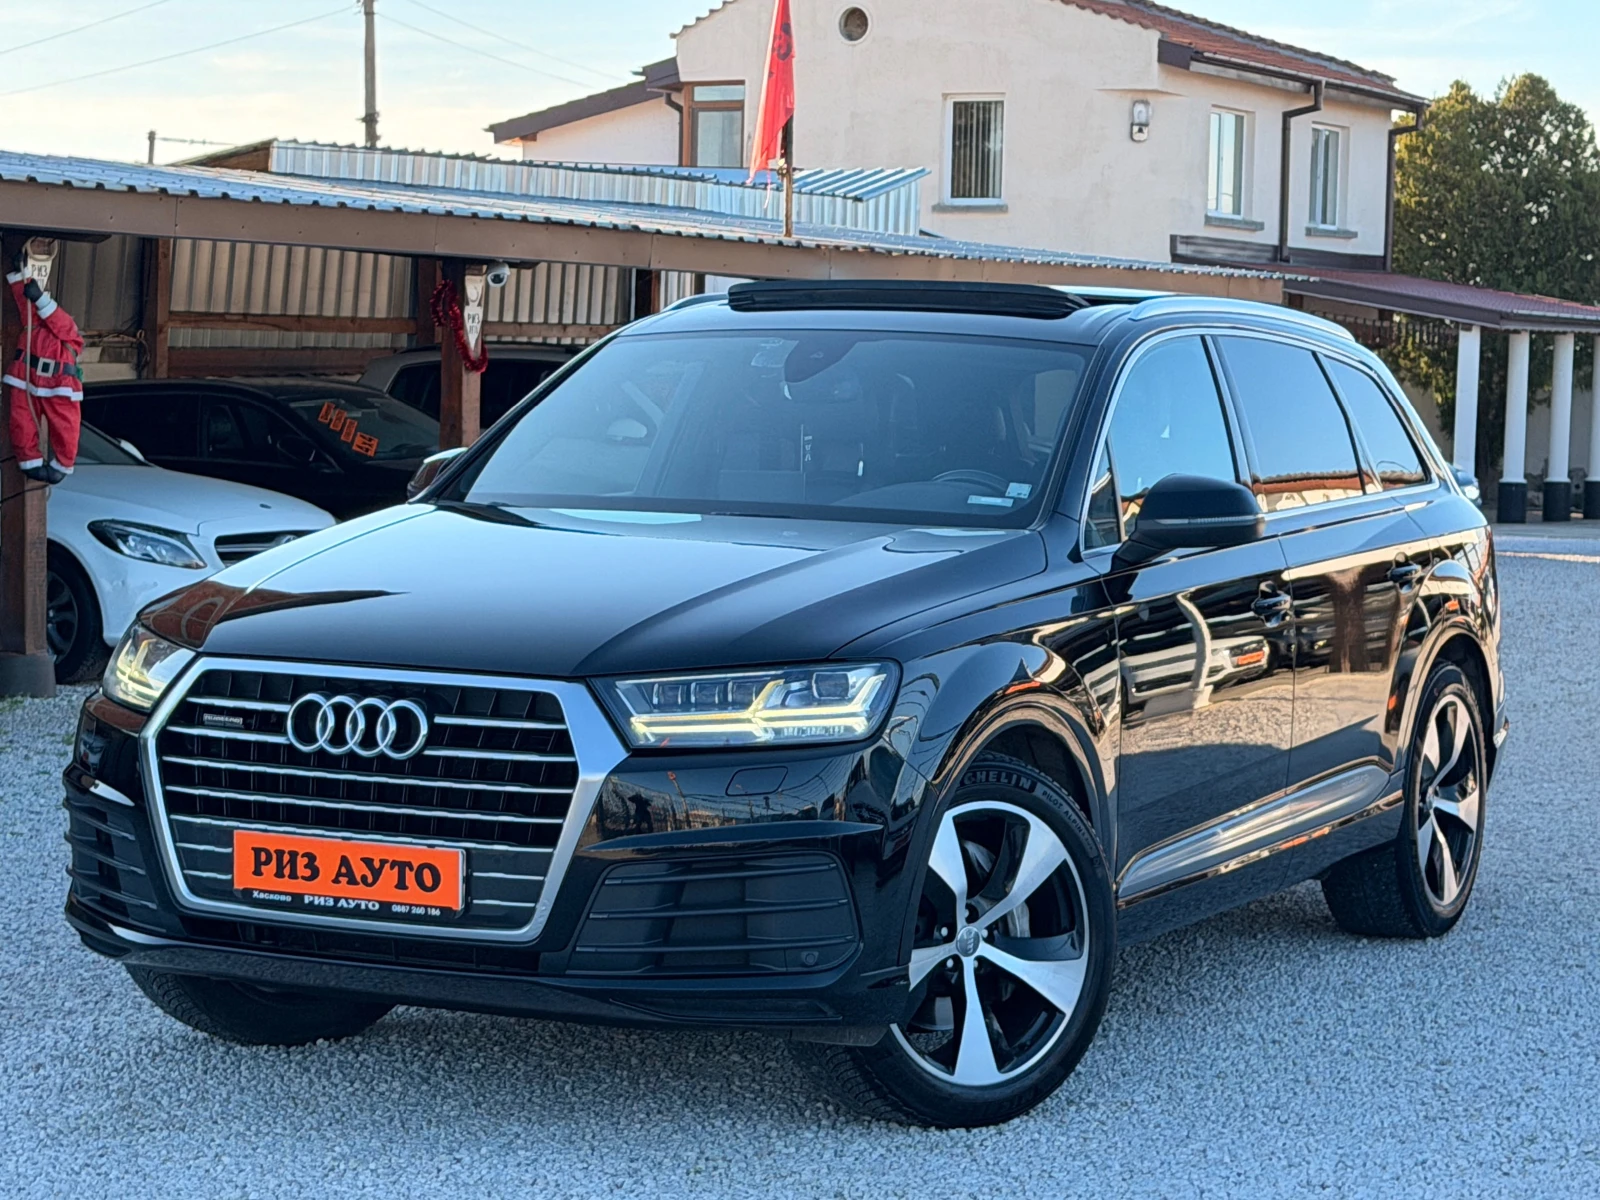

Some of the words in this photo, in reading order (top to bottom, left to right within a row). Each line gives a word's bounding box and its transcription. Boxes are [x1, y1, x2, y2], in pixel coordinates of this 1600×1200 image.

[963, 771, 1032, 790] CHELIN
[251, 846, 320, 882] РИЗ
[331, 854, 441, 893] АУТО
[304, 895, 334, 907] РИЗ
[337, 898, 380, 911] АУТО
